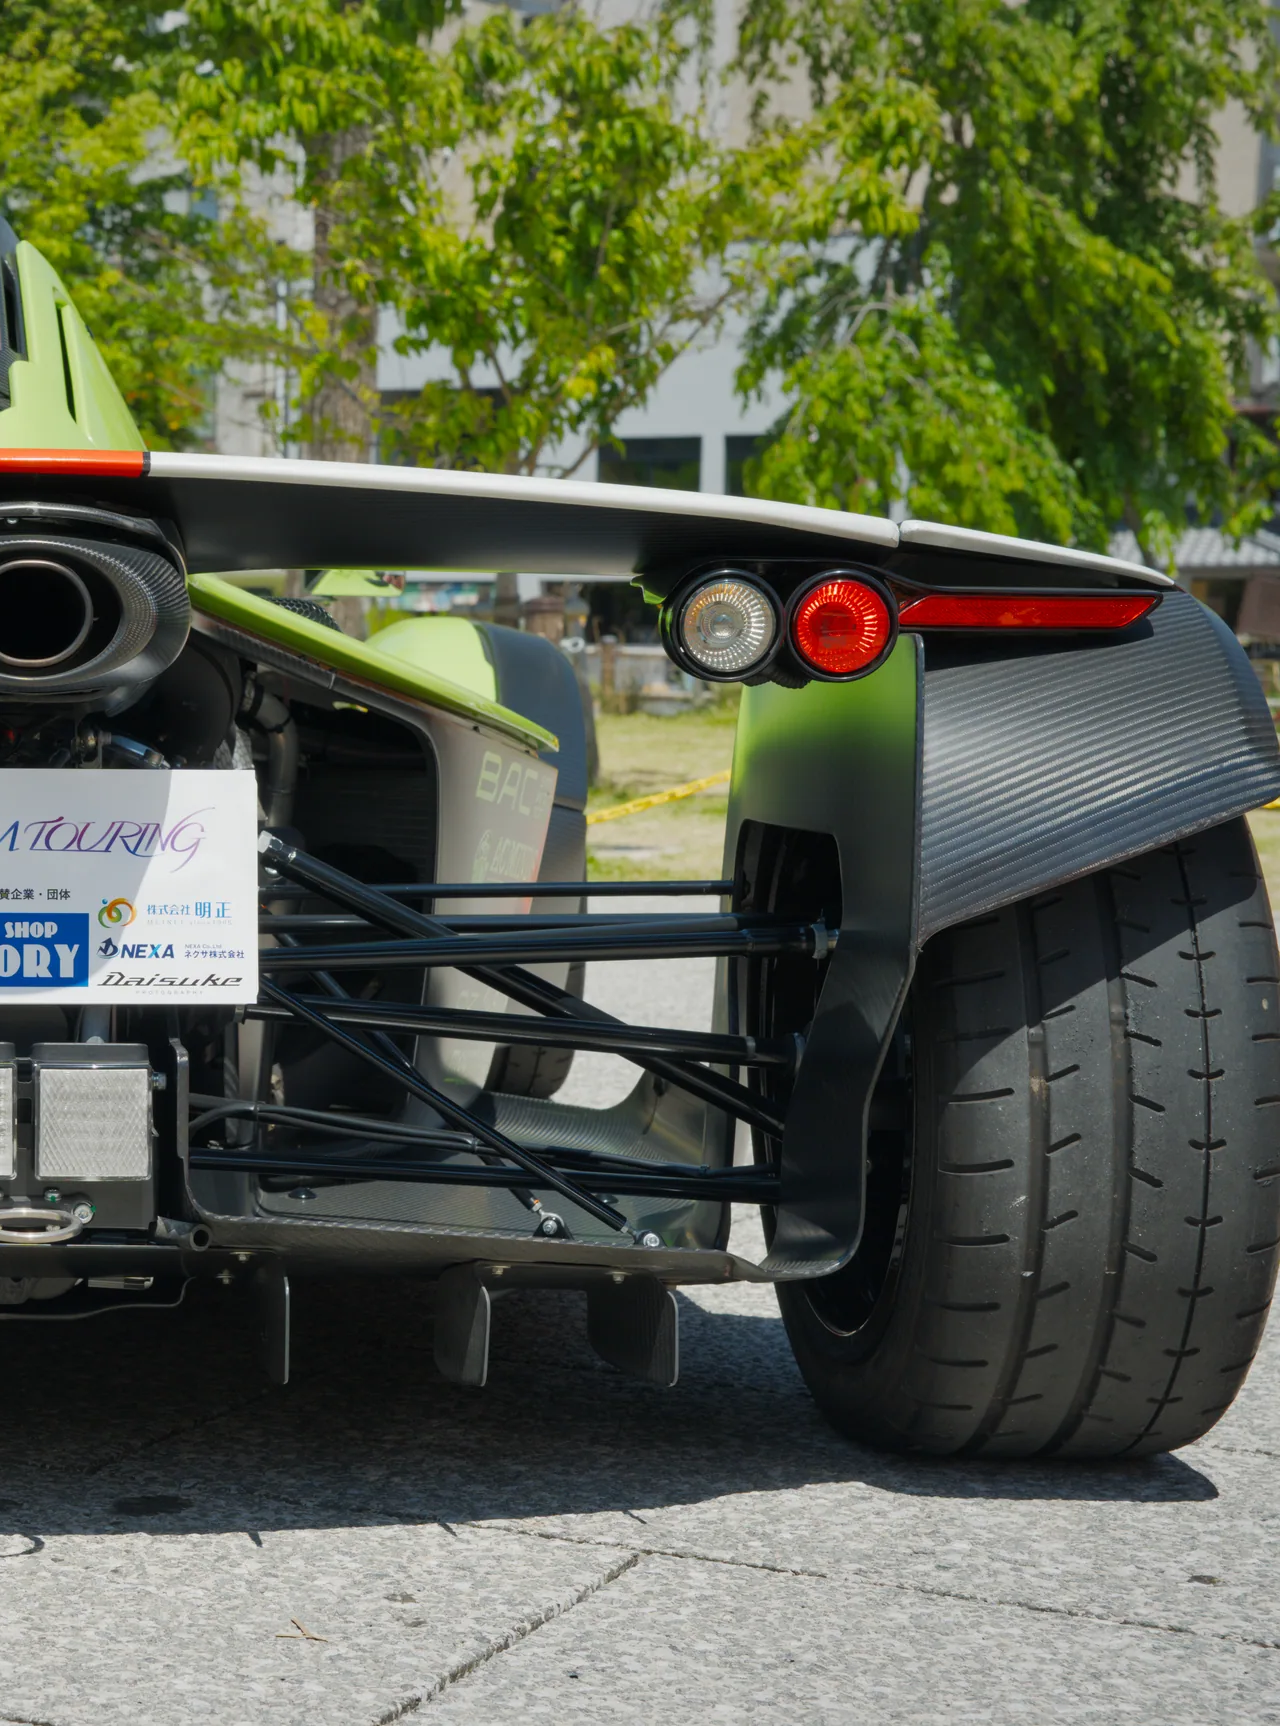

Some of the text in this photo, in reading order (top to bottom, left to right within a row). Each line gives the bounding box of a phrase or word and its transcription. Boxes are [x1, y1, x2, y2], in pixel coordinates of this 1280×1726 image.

[476, 750, 539, 816] BAC
[24, 806, 216, 873] TOURING
[147, 901, 233, 919] 株式会社 明正
[4, 921, 58, 939] SHOP
[120, 943, 175, 959] NEXA
[184, 950, 245, 959] ネクサ株式会社
[97, 971, 243, 987] Daisuke
